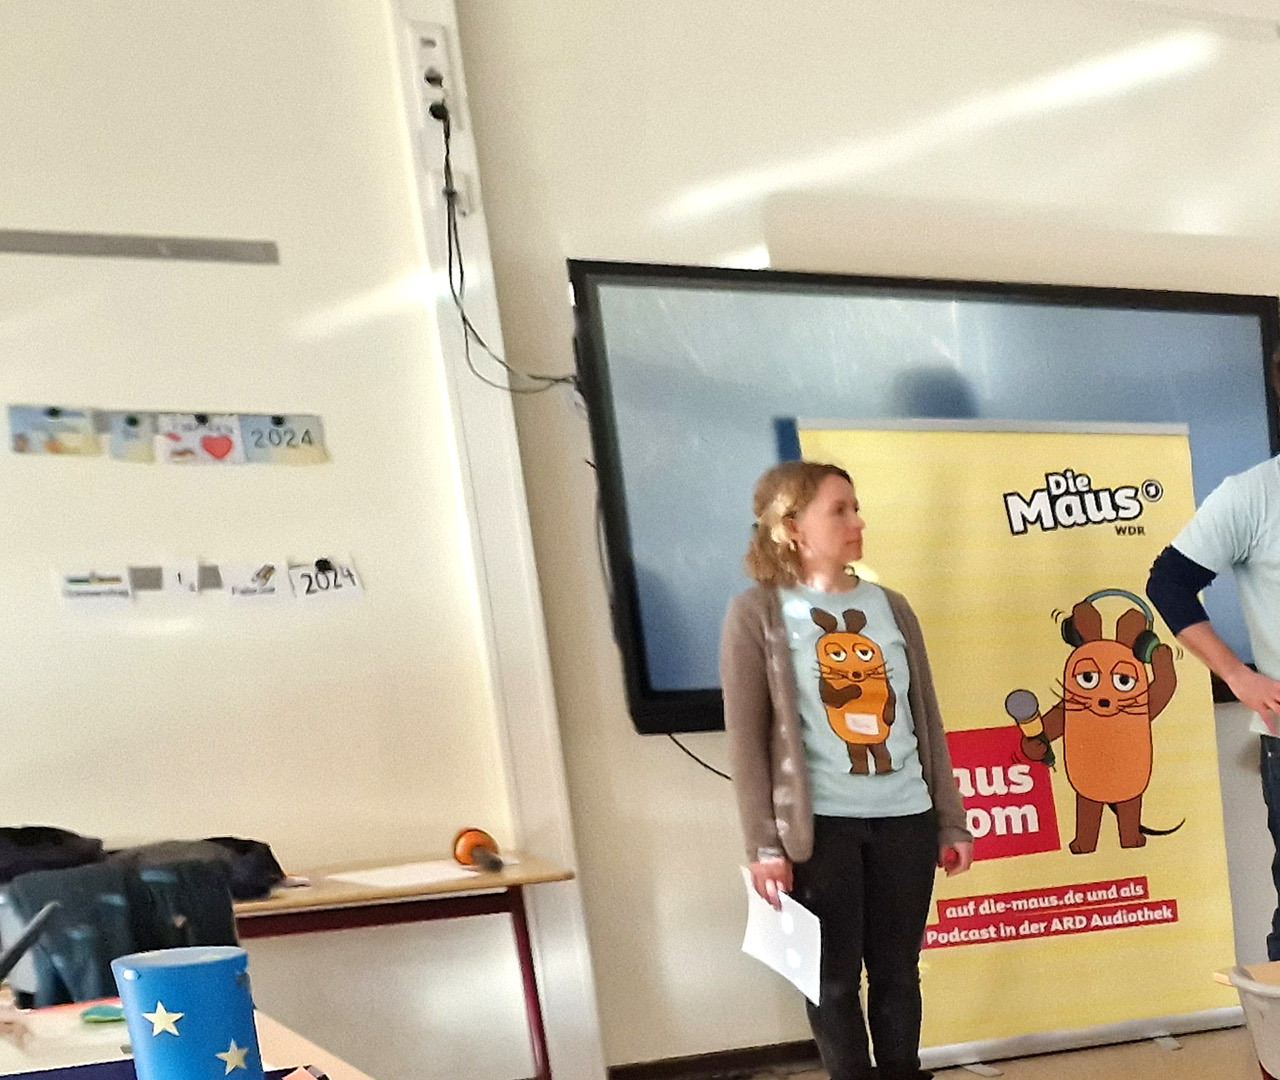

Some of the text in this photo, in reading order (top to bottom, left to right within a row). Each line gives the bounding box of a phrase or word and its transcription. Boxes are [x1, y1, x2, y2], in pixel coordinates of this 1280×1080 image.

[251, 429, 314, 448] 2024
[1045, 469, 1091, 495] Die
[1003, 486, 1144, 536] Maus
[1115, 526, 1146, 536] WDR
[300, 565, 357, 596] 2024
[952, 764, 1035, 798] aus
[966, 804, 1040, 838] om
[946, 882, 1145, 919] auf die-maus.de und als
[926, 904, 1174, 945] Podcast in der ARD Audiothek
